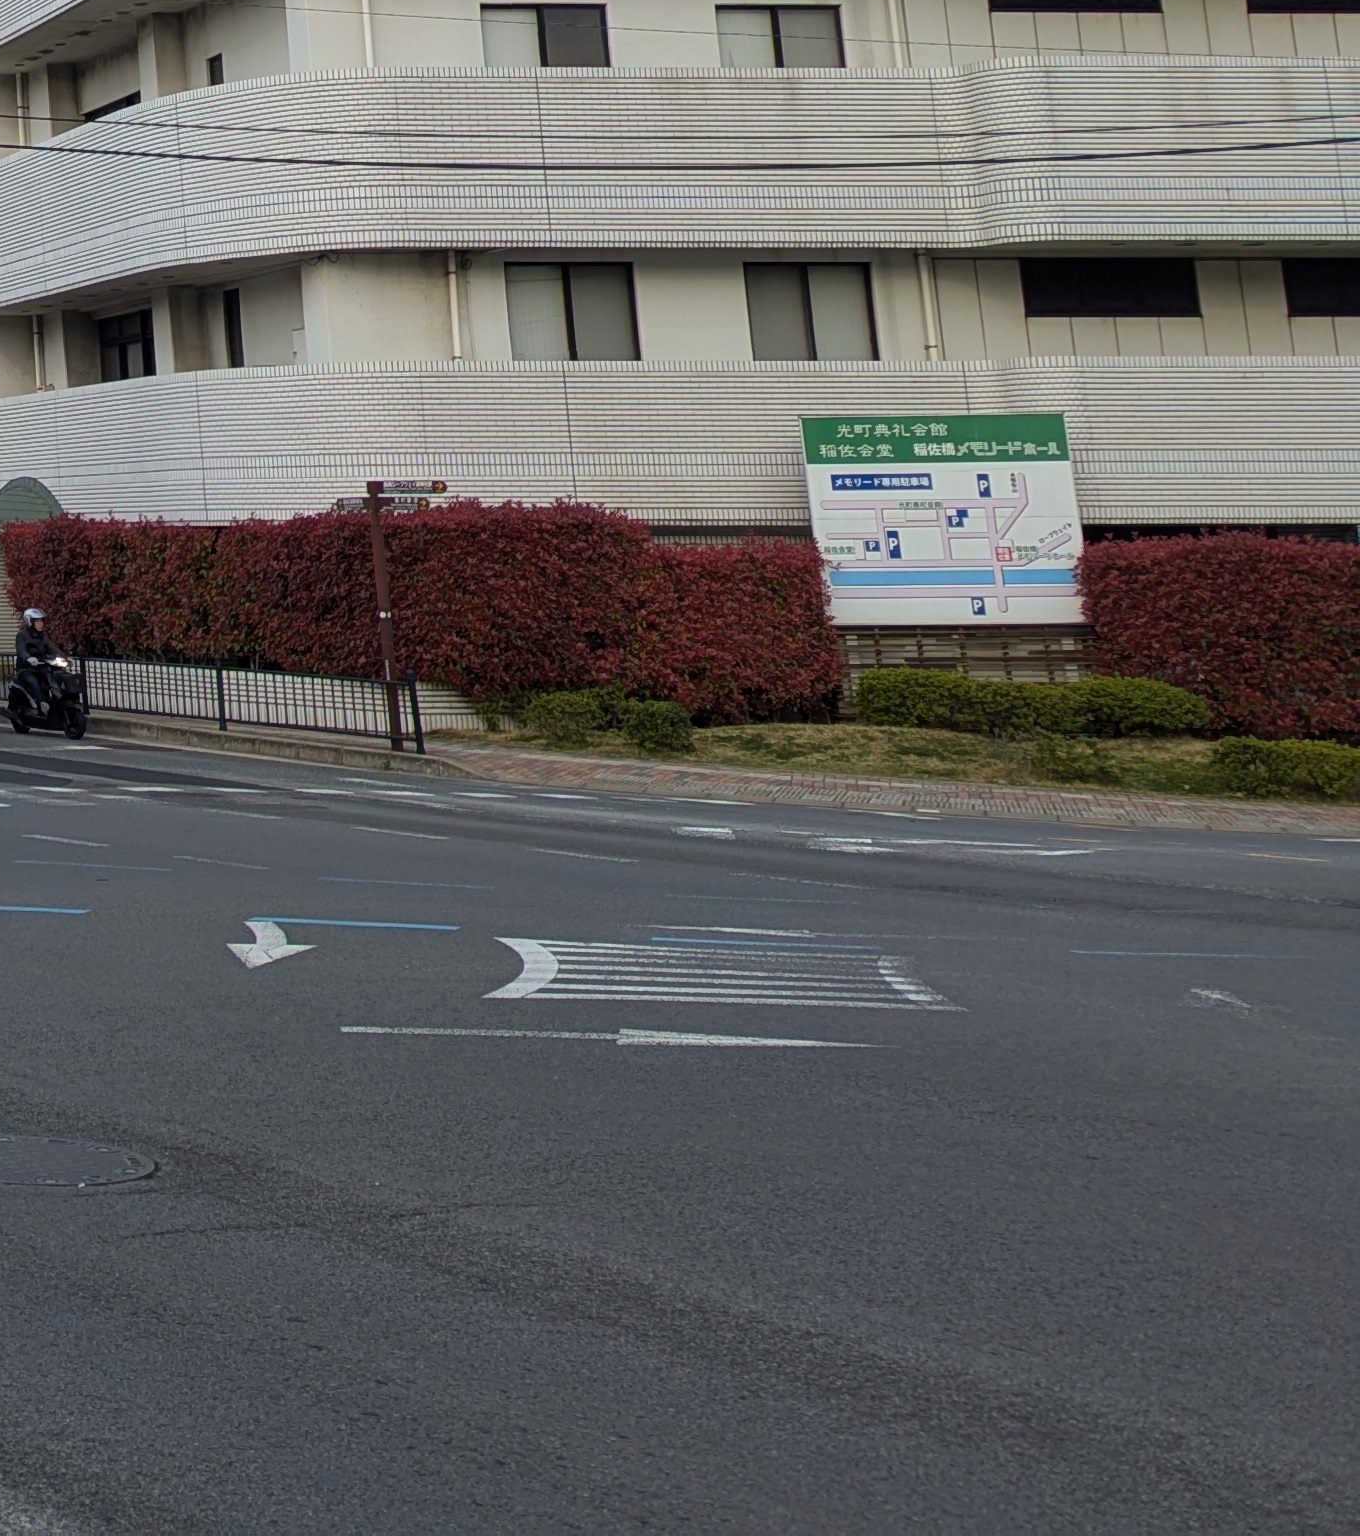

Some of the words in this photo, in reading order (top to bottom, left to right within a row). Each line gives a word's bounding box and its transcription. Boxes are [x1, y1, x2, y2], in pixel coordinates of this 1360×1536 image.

[819, 443, 895, 459] 稲佐会堂
[979, 479, 988, 492] P
[952, 516, 960, 526] P
[869, 541, 876, 550] P
[888, 537, 898, 551] P
[973, 599, 983, 612] P
